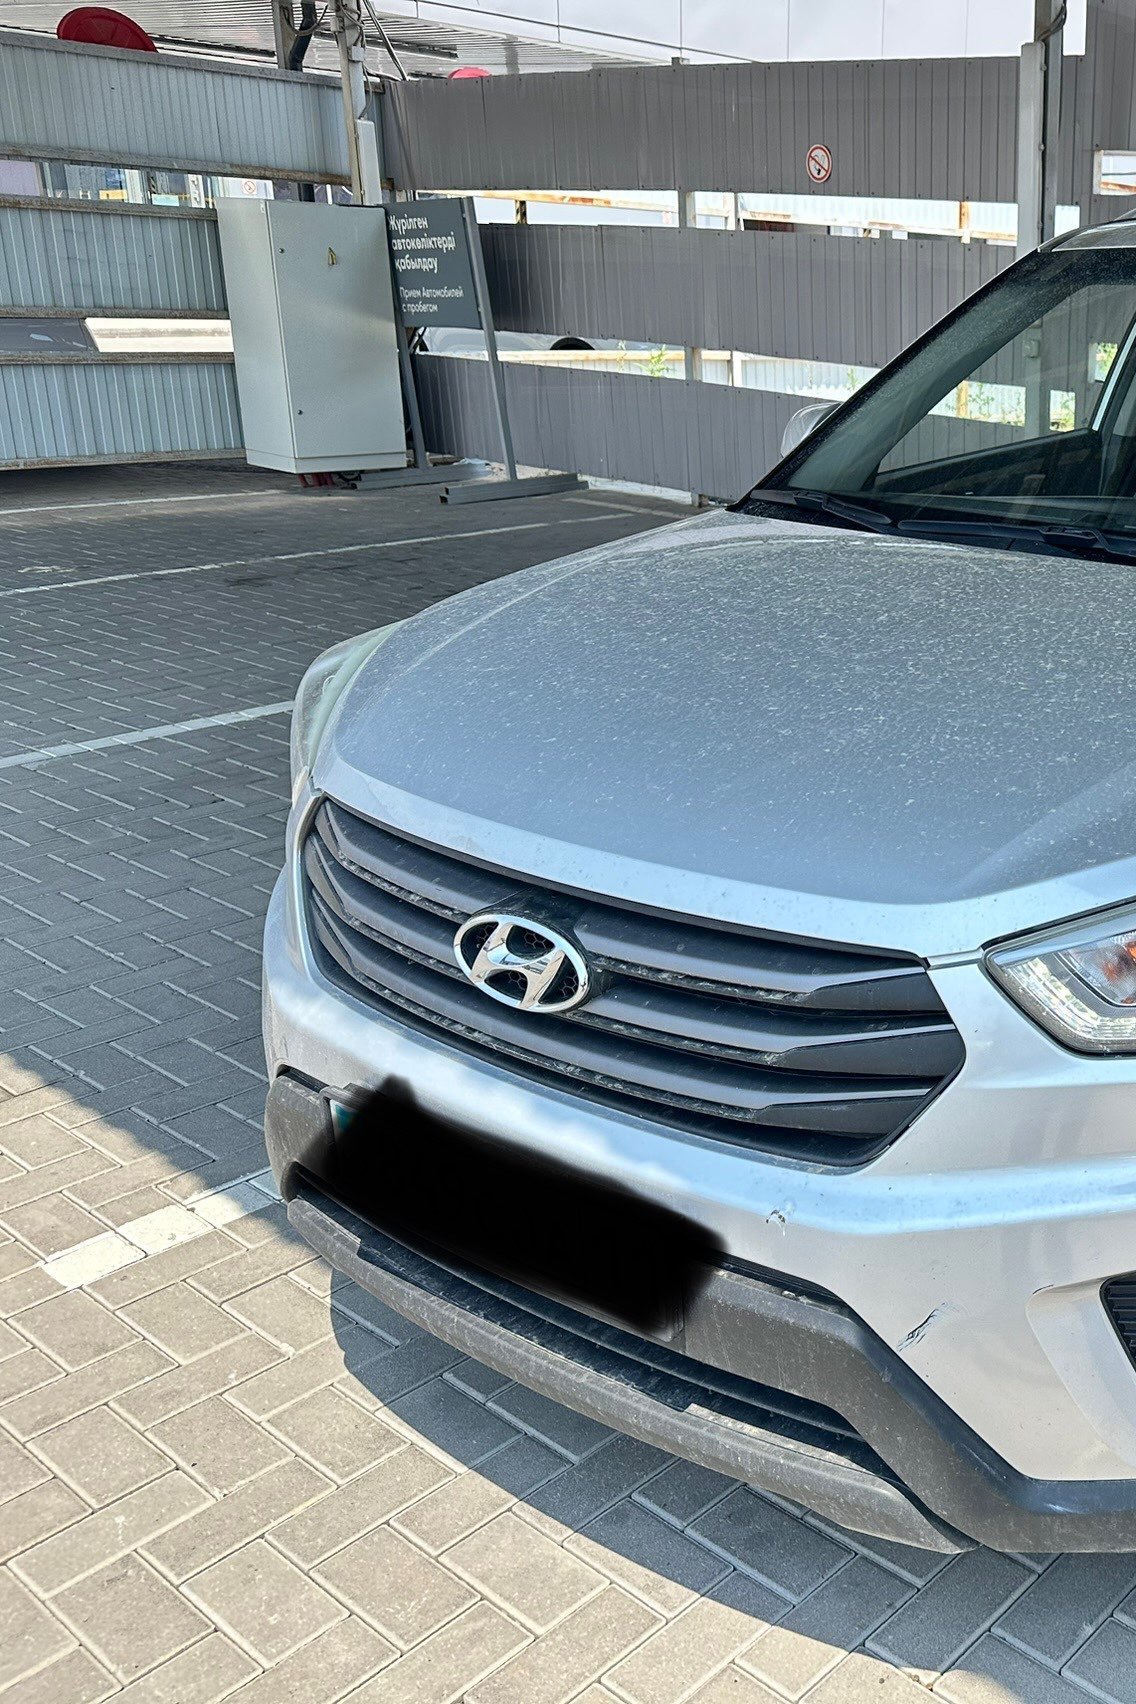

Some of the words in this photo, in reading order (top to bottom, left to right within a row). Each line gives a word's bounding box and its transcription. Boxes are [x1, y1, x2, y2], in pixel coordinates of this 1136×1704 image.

[392, 232, 455, 252] автокөліктерді
[395, 254, 438, 273] қабылдау
[407, 301, 438, 315] пробегом
